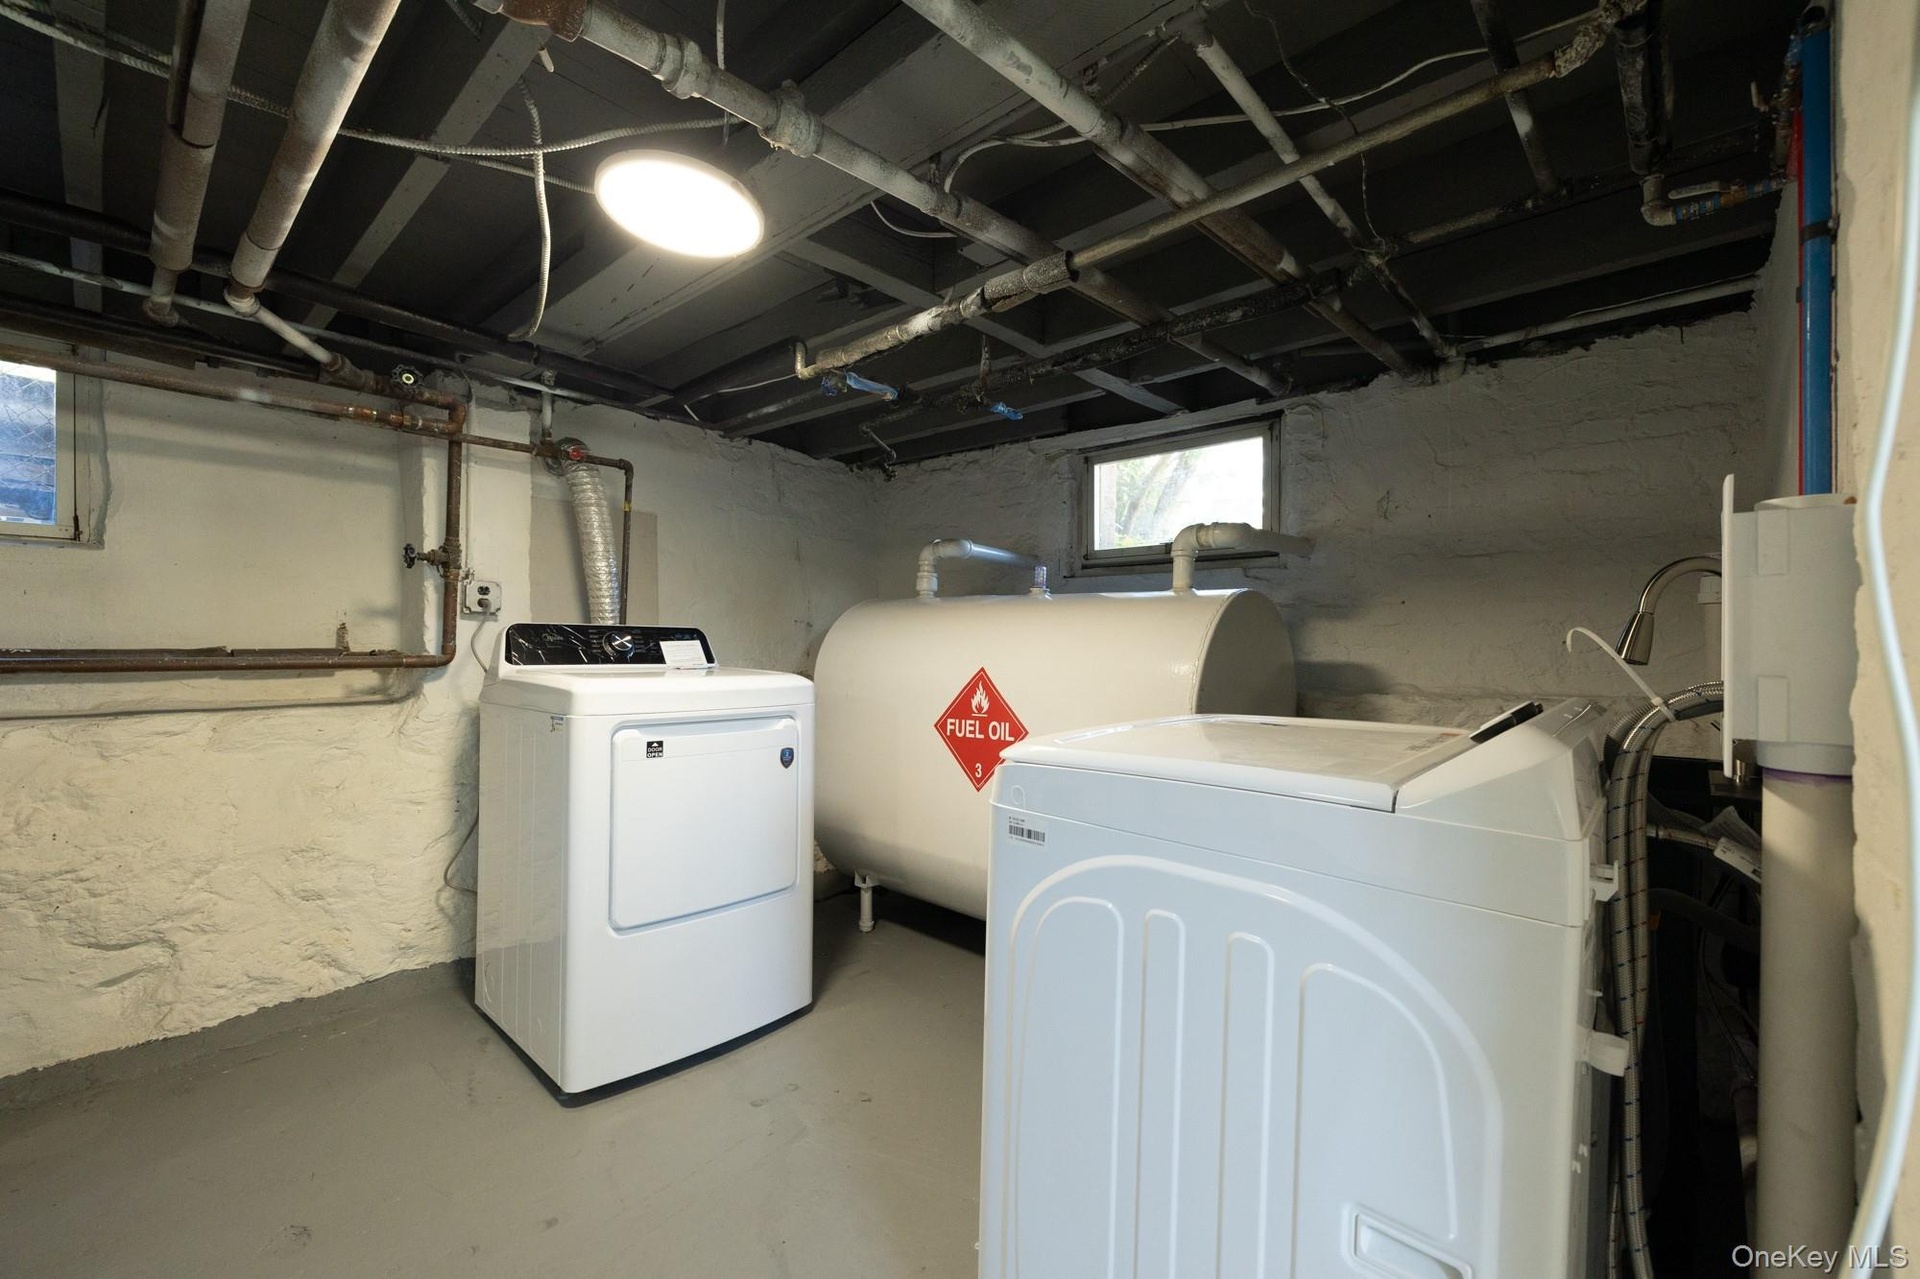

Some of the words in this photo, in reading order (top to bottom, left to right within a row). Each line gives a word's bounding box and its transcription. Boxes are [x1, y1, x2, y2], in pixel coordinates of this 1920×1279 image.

[946, 718, 985, 739] FUEL
[988, 721, 1015, 742] OIL
[975, 763, 982, 778] 3
